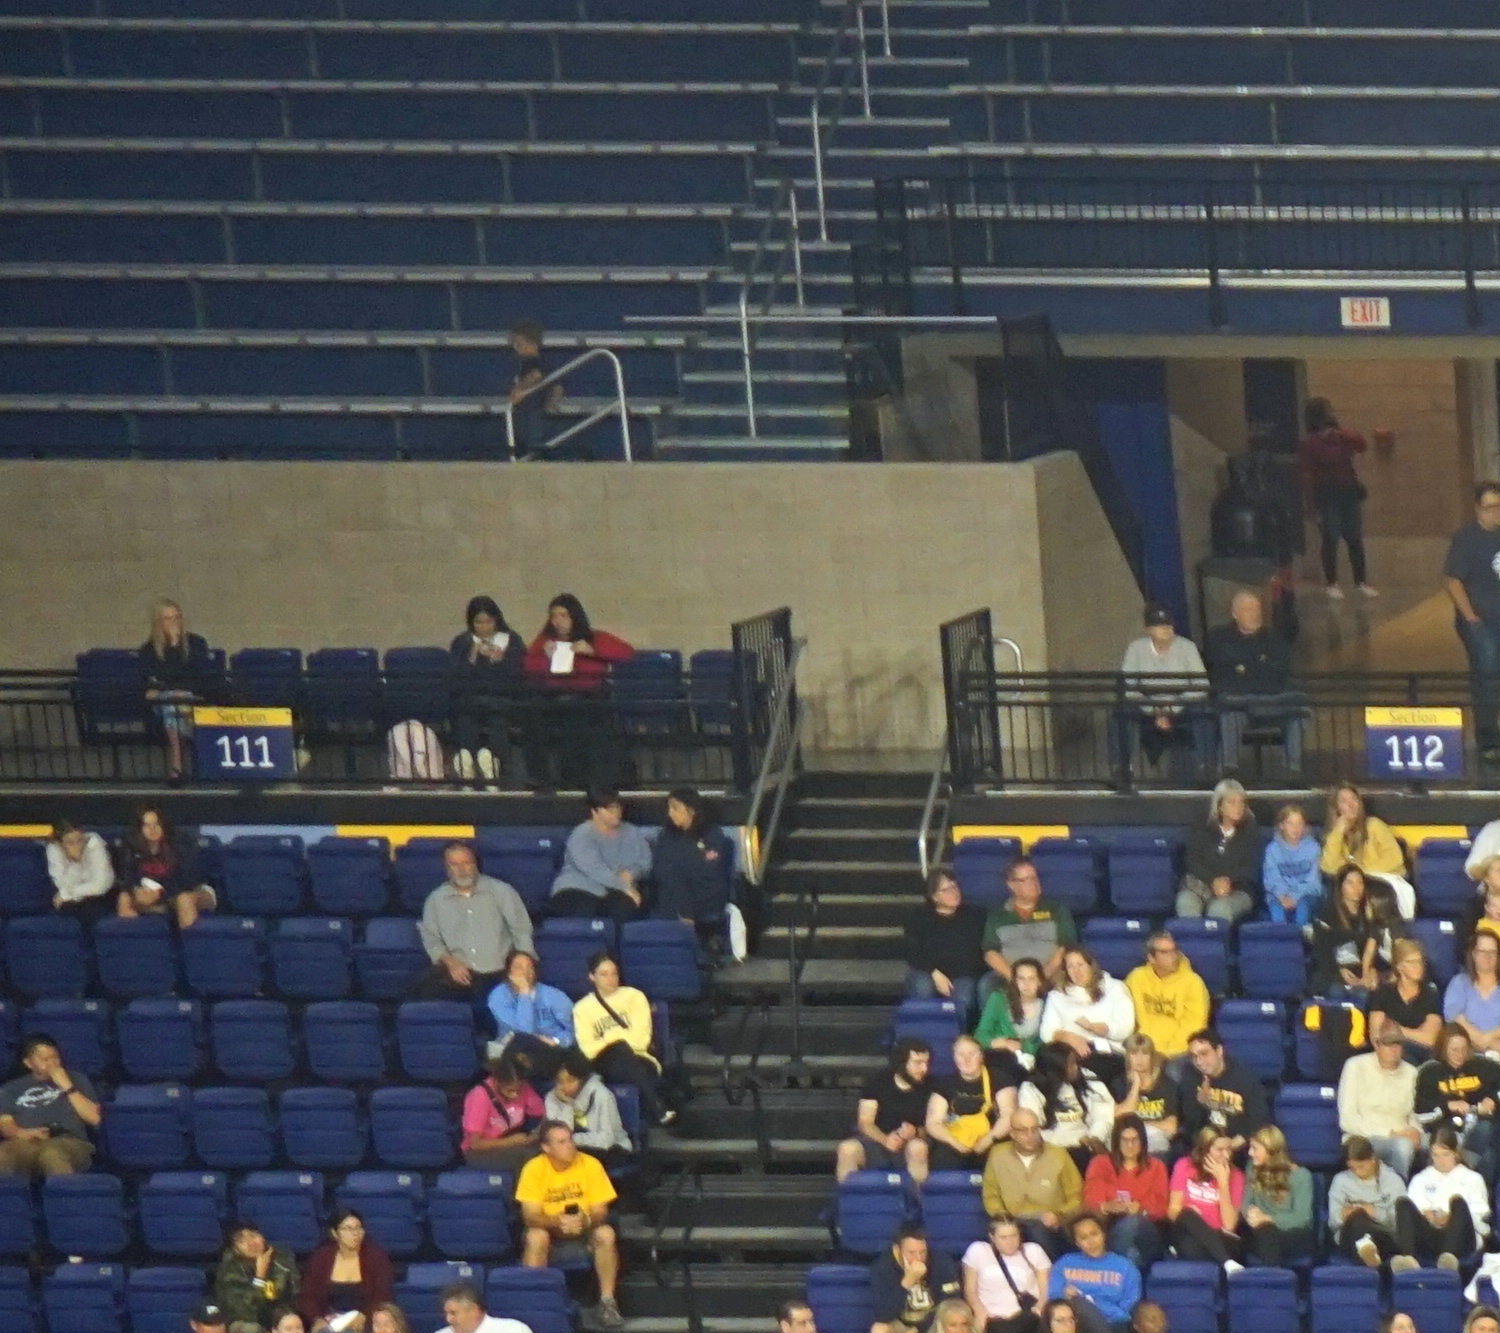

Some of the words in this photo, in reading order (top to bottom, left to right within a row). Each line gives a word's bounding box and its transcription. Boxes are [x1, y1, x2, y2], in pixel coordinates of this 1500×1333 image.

[1350, 300, 1381, 322] EXIT
[219, 711, 267, 724] Section
[1390, 711, 1438, 724] Section
[217, 735, 275, 769] 111
[1386, 735, 1444, 769] 112
